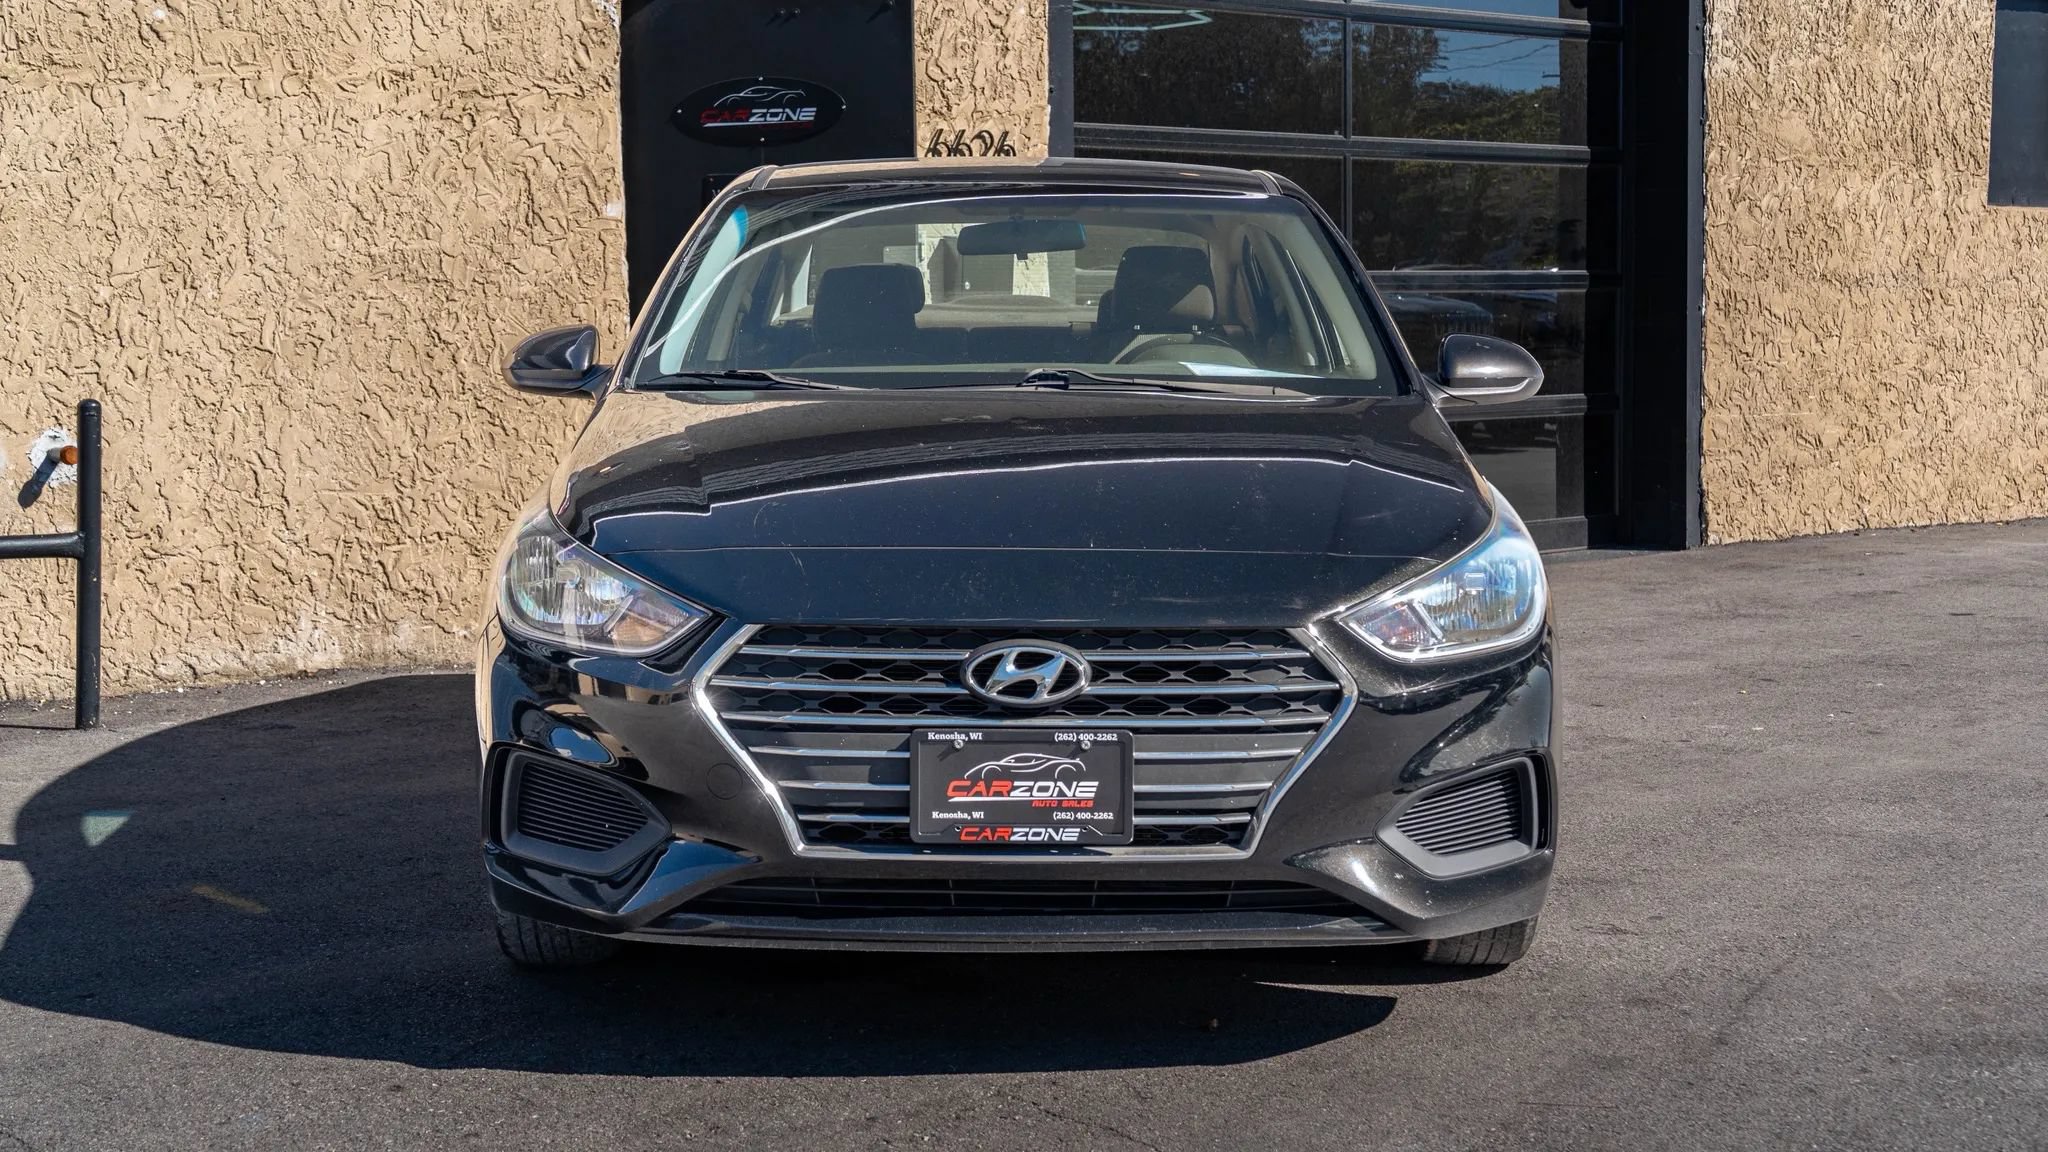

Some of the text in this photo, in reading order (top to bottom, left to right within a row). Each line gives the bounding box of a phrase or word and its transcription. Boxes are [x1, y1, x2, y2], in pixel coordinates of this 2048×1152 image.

[699, 107, 817, 122] CARZONE
[927, 732, 983, 741] Kenosha, WI
[1054, 732, 1118, 741] (262) 400-2262
[947, 780, 1099, 798] CARZONE
[1032, 799, 1094, 808] AUTO SALES
[931, 811, 985, 820] Kenosha, WI
[1053, 811, 1114, 820] (262) 400-2262
[960, 826, 1080, 841] CARZONE
